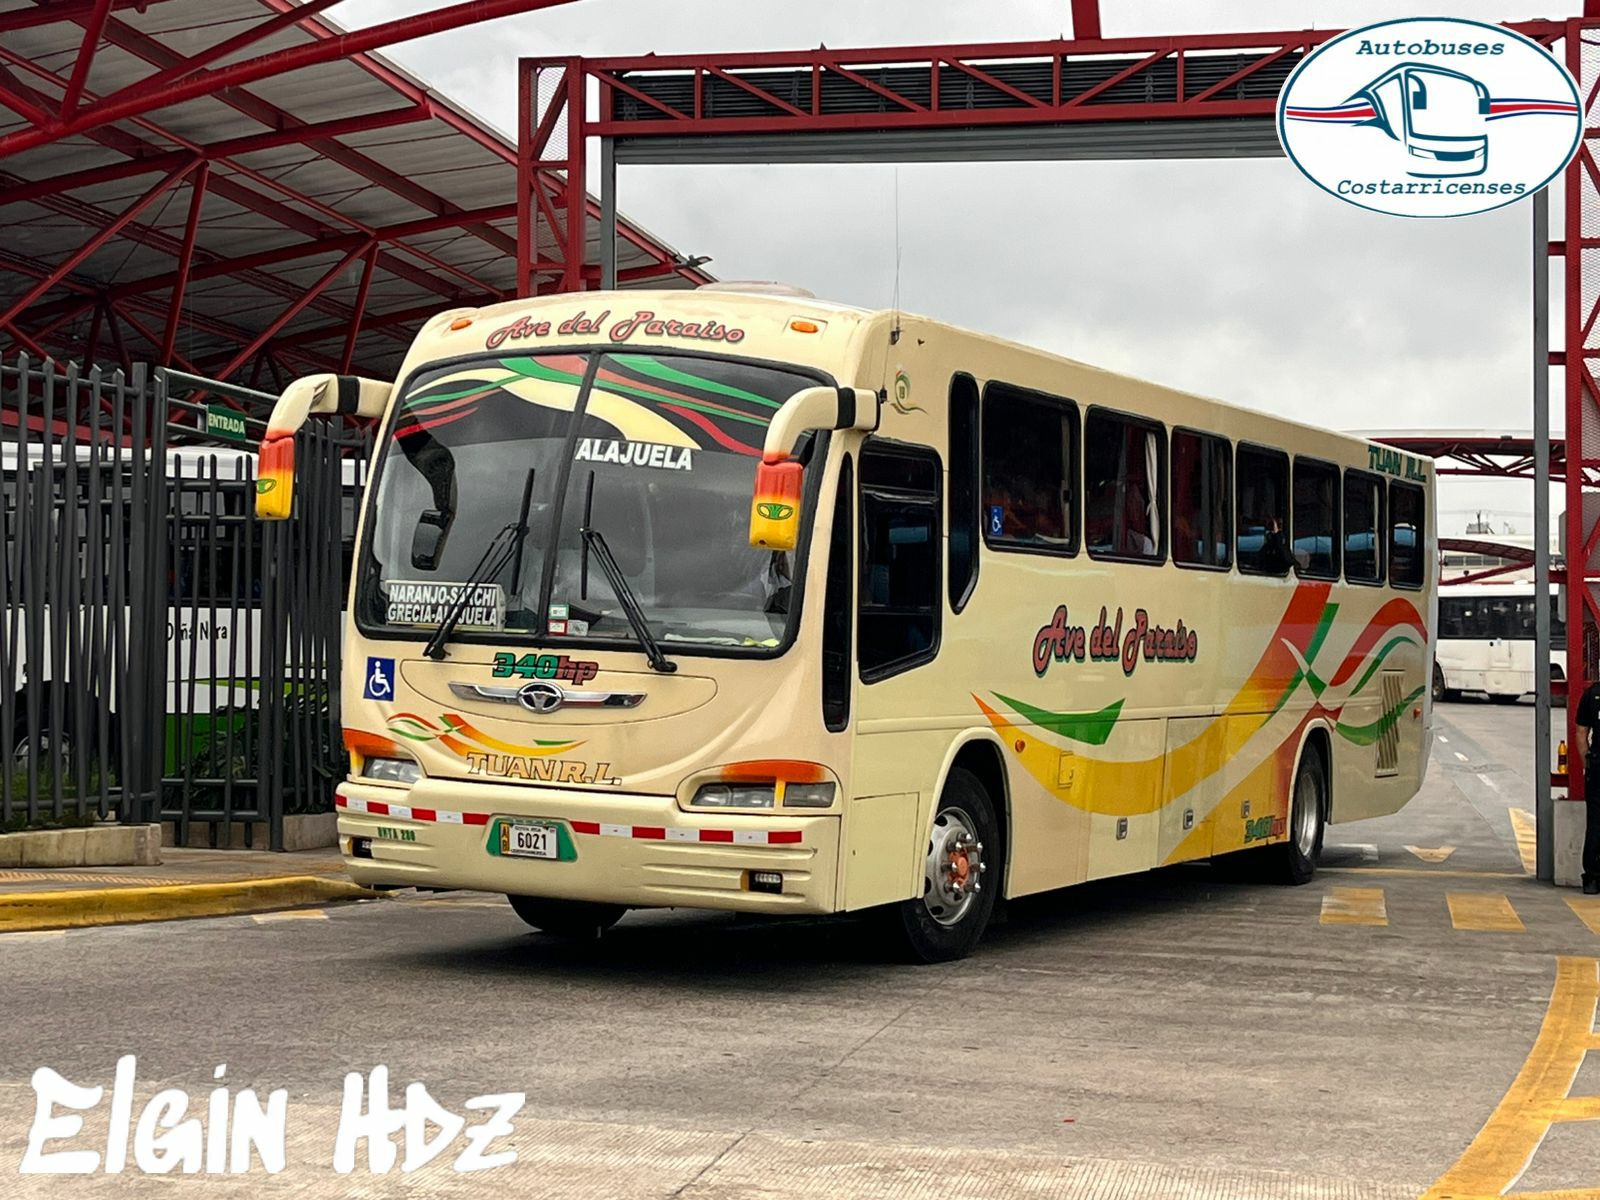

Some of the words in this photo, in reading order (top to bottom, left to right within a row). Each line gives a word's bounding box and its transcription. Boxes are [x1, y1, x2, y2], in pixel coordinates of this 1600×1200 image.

[486, 316, 551, 349] Ave
[557, 310, 611, 334] del
[609, 311, 745, 343] Paraiso
[208, 412, 246, 434] ENTRADA
[574, 438, 692, 471] ALAJUELA
[1368, 444, 1402, 476] TUAN
[200, 620, 228, 641] Nra
[1033, 604, 1086, 678] Ave
[1089, 605, 1124, 662] del
[1122, 608, 1198, 677] Paraiso
[492, 651, 600, 686] 340hp
[517, 831, 547, 850] 6021
